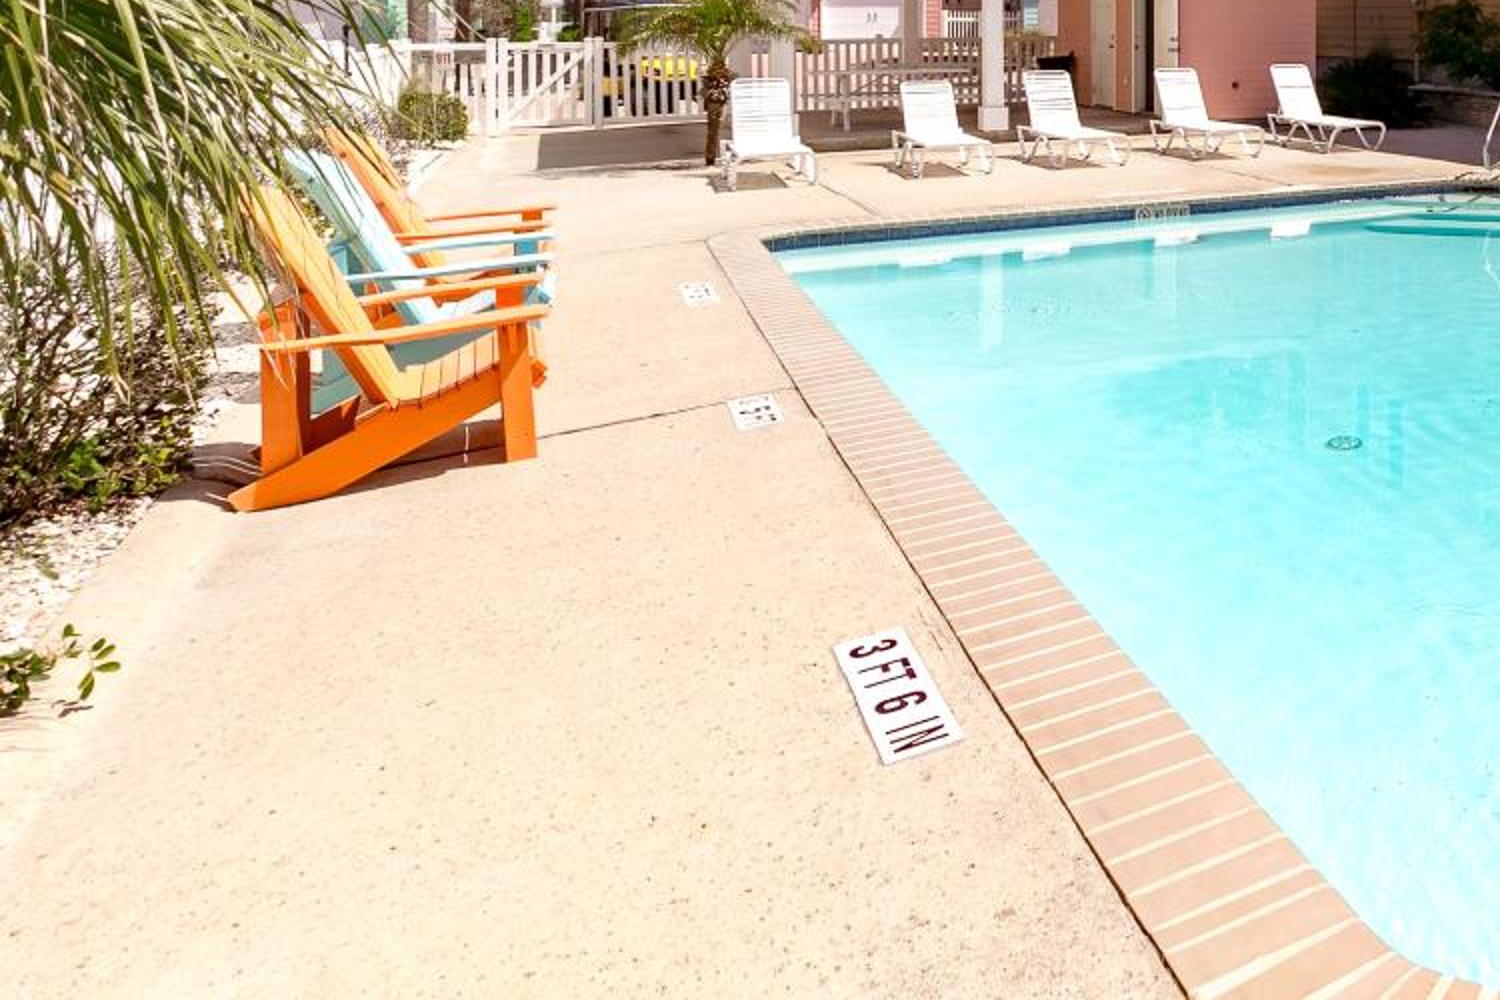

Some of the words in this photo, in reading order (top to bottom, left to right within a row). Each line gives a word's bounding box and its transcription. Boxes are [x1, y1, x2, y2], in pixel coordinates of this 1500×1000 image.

[849, 639, 897, 659] 3
[858, 657, 917, 689] FT
[875, 690, 927, 715] 6
[885, 715, 950, 753] IN
